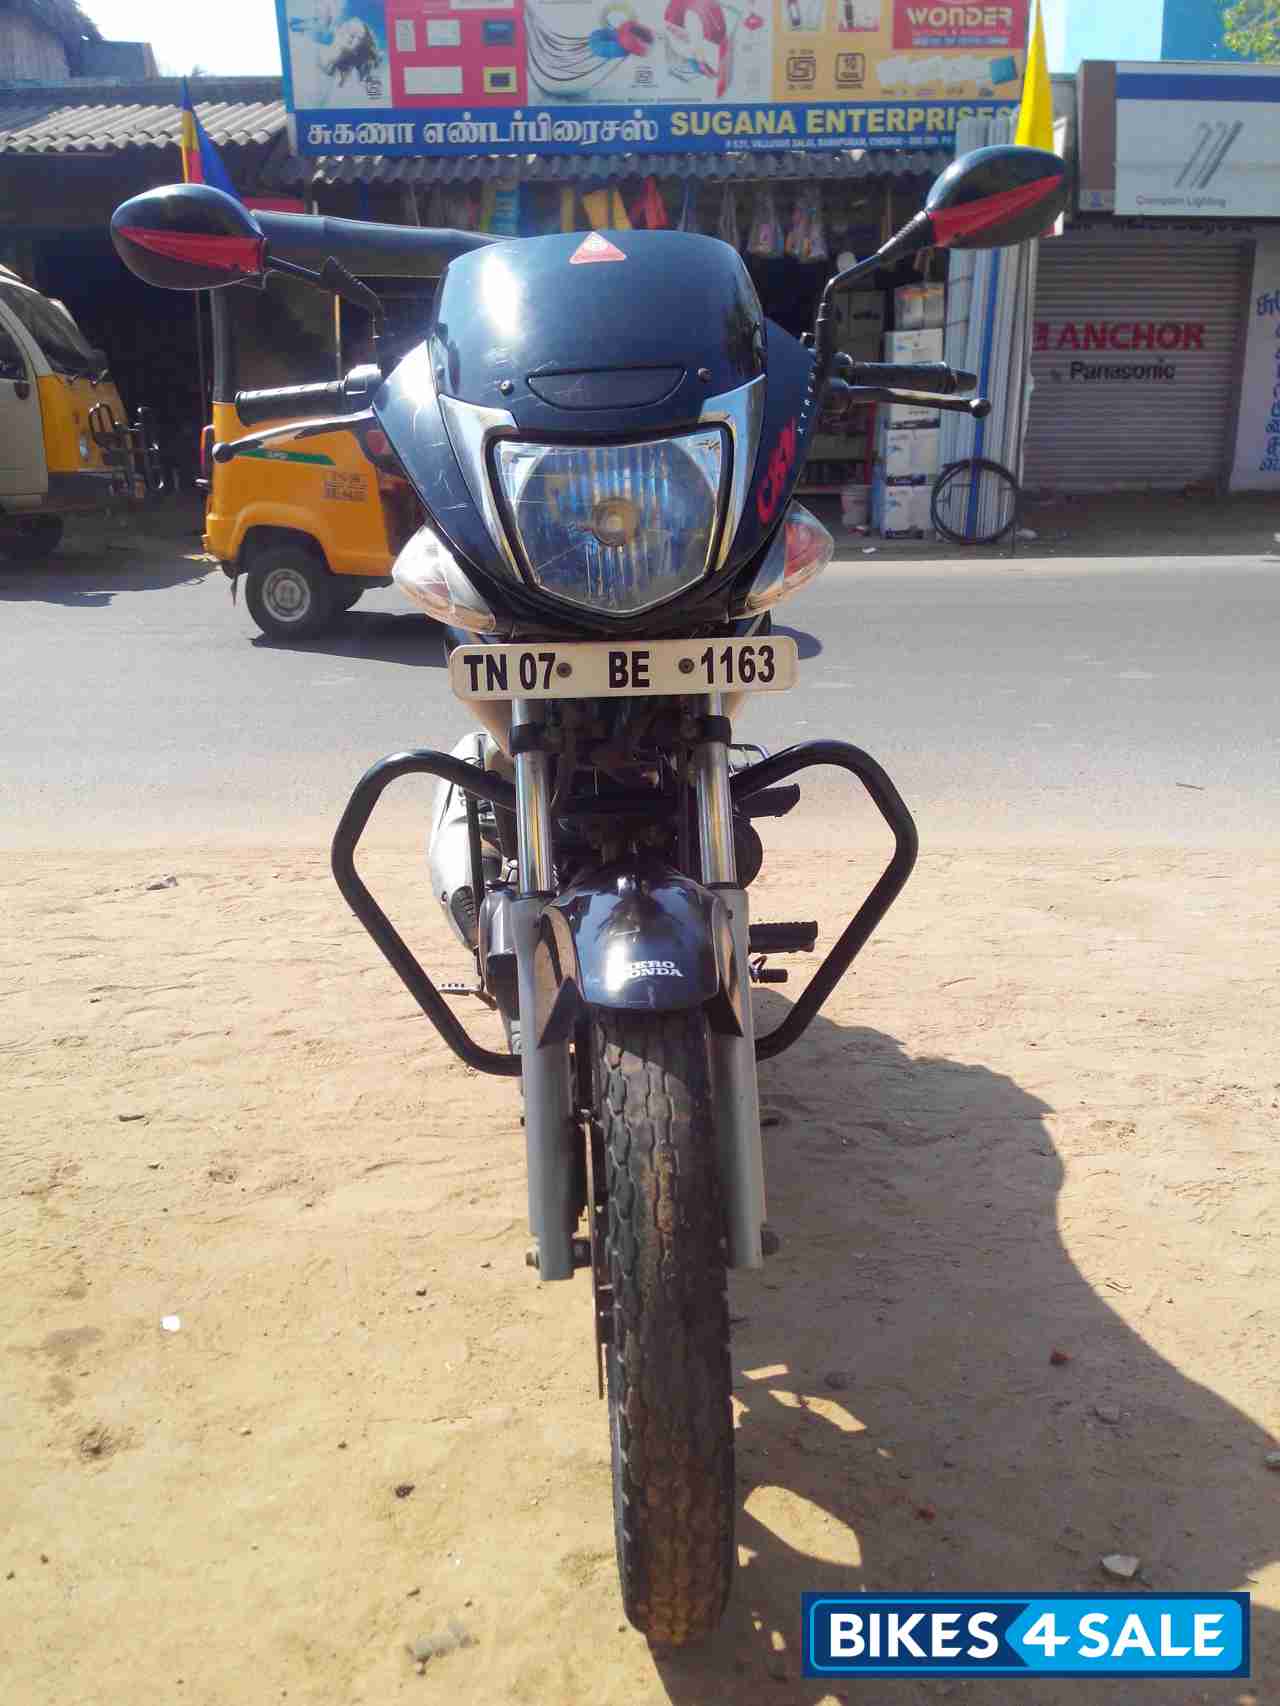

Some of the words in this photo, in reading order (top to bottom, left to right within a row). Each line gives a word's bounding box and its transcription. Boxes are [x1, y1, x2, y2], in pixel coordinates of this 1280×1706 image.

[671, 109, 797, 136] SUGANA
[1057, 320, 1205, 351] ANCHOR
[1069, 356, 1176, 380] Panasonic
[463, 653, 508, 692] TN
[519, 652, 556, 690] 07
[608, 650, 650, 689] BE
[700, 645, 775, 685] 1163
